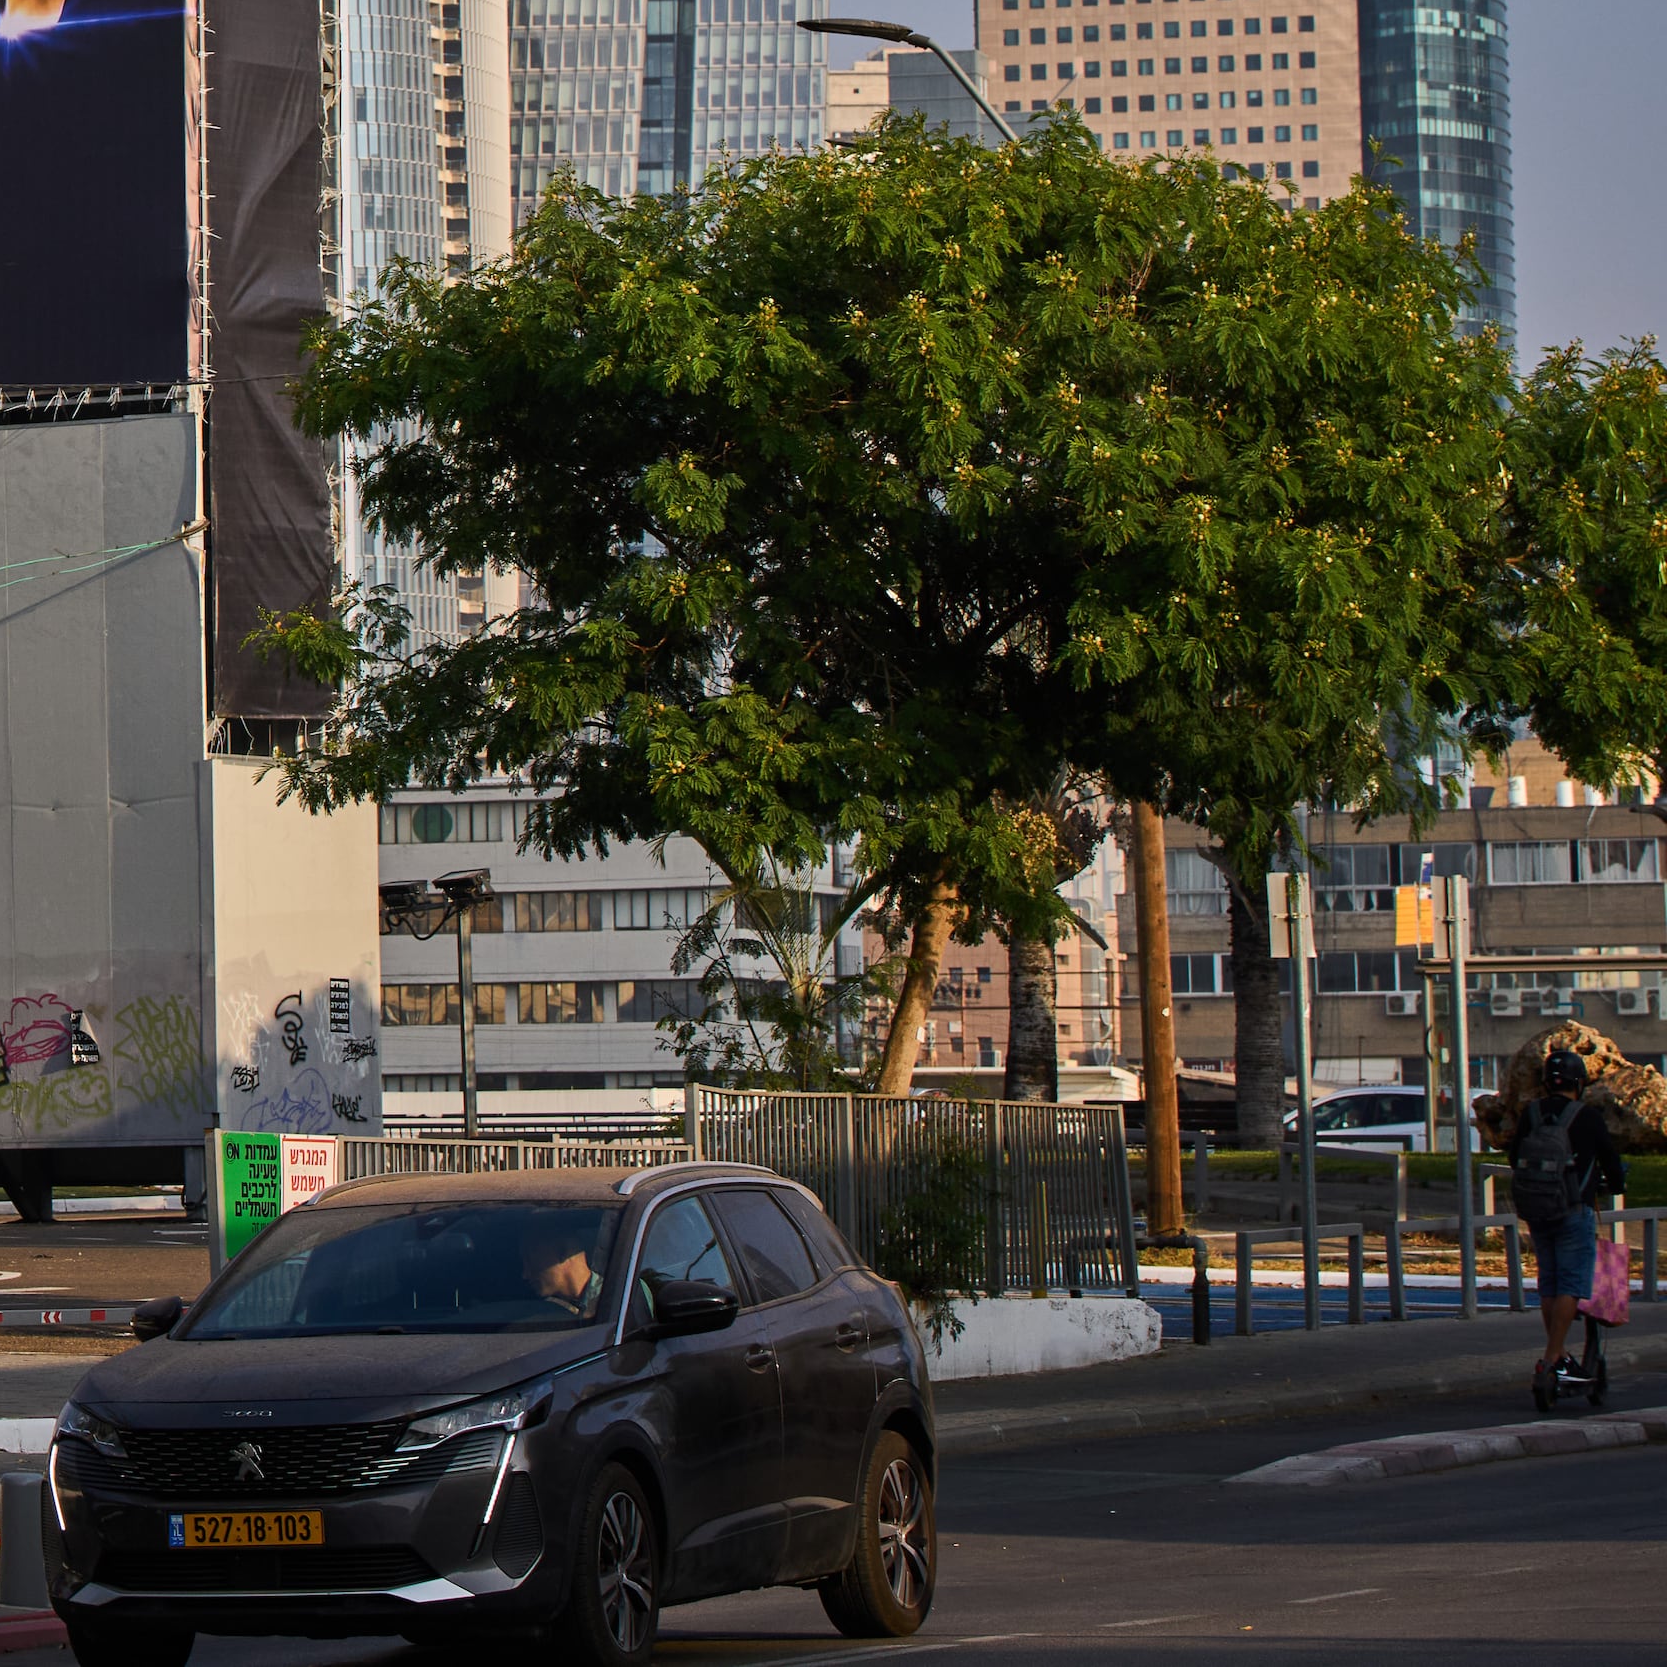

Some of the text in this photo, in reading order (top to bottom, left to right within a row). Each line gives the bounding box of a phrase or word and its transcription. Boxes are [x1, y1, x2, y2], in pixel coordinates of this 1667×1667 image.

[245, 1144, 277, 1161] עמדות
[290, 1149, 327, 1166] המגרש
[248, 1163, 277, 1179] טעינה
[241, 1180, 277, 1198] לרכבים
[291, 1175, 325, 1191] משמש
[235, 1198, 277, 1217] חשמליים
